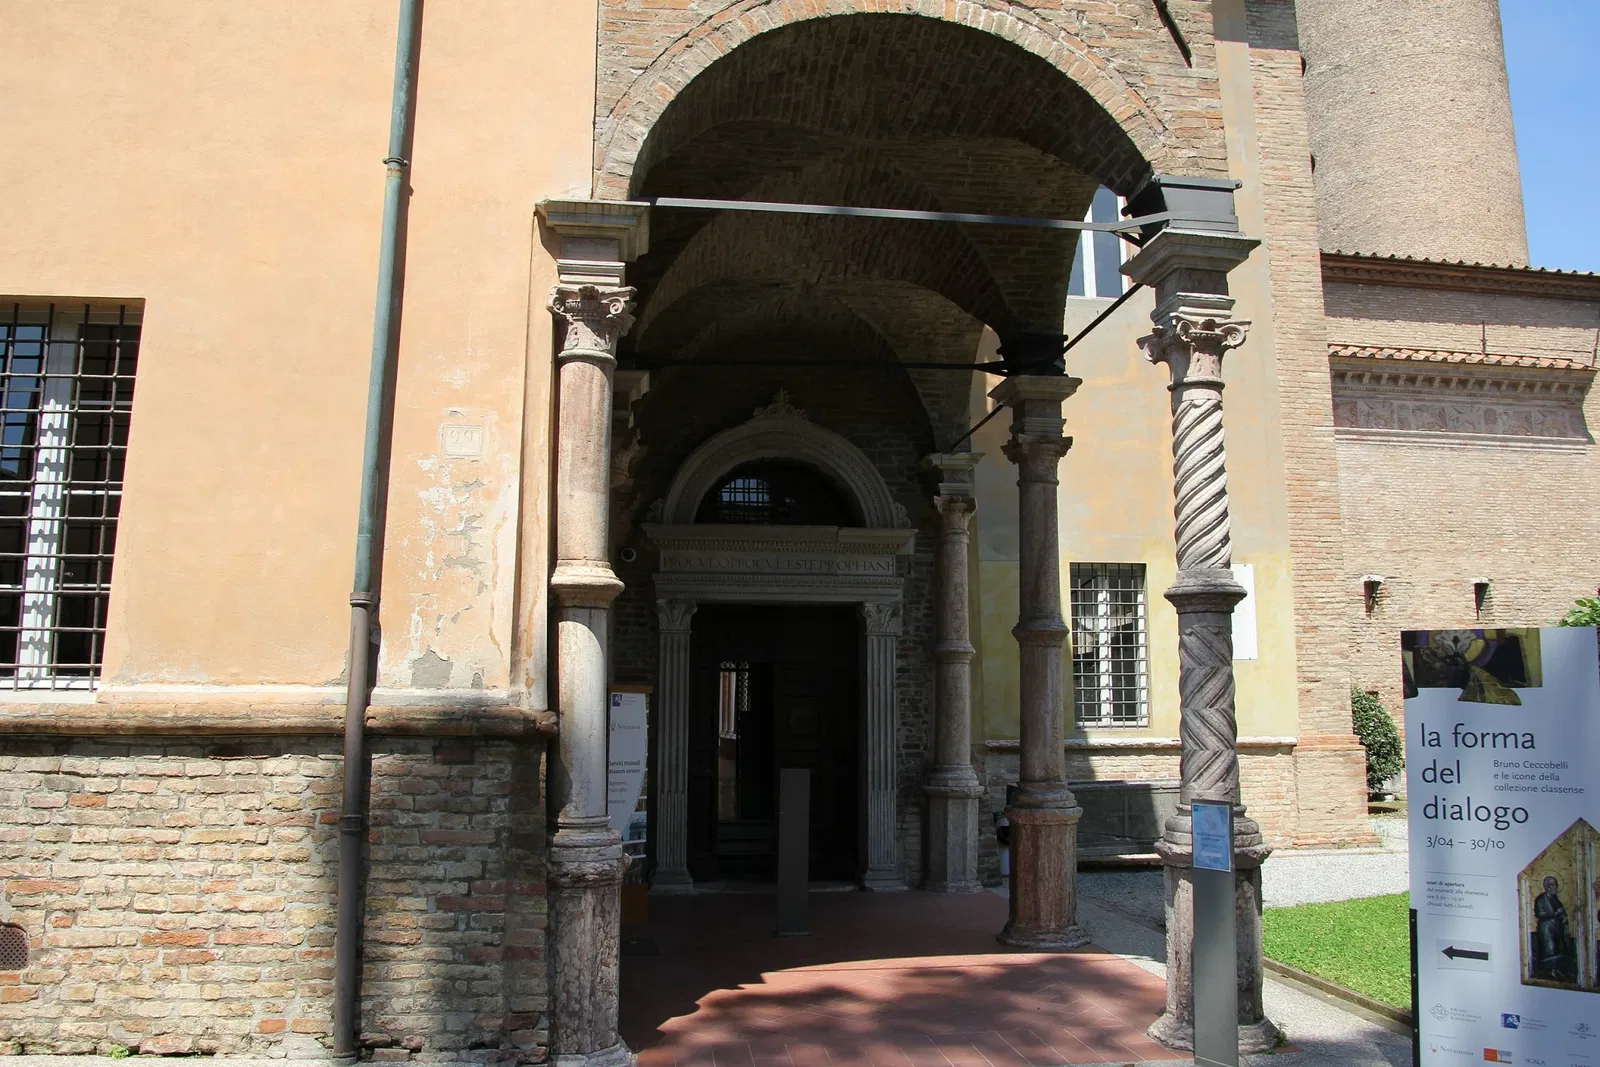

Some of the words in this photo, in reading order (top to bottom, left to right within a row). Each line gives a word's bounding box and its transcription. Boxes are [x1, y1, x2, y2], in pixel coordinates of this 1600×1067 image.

[1420, 722, 1442, 748] la
[1451, 722, 1536, 750] forma
[1421, 758, 1461, 785] del
[1493, 759, 1520, 769] Bruno
[1522, 760, 1569, 770] Ceccobelli
[1501, 772, 1510, 780] le
[1512, 772, 1537, 781] icone
[1538, 772, 1560, 782] della
[1493, 784, 1538, 793] collezione
[1540, 785, 1585, 795] classense
[1422, 794, 1529, 831] dialogo
[1426, 834, 1454, 849] 3/04
[1470, 836, 1506, 850] 30/10
